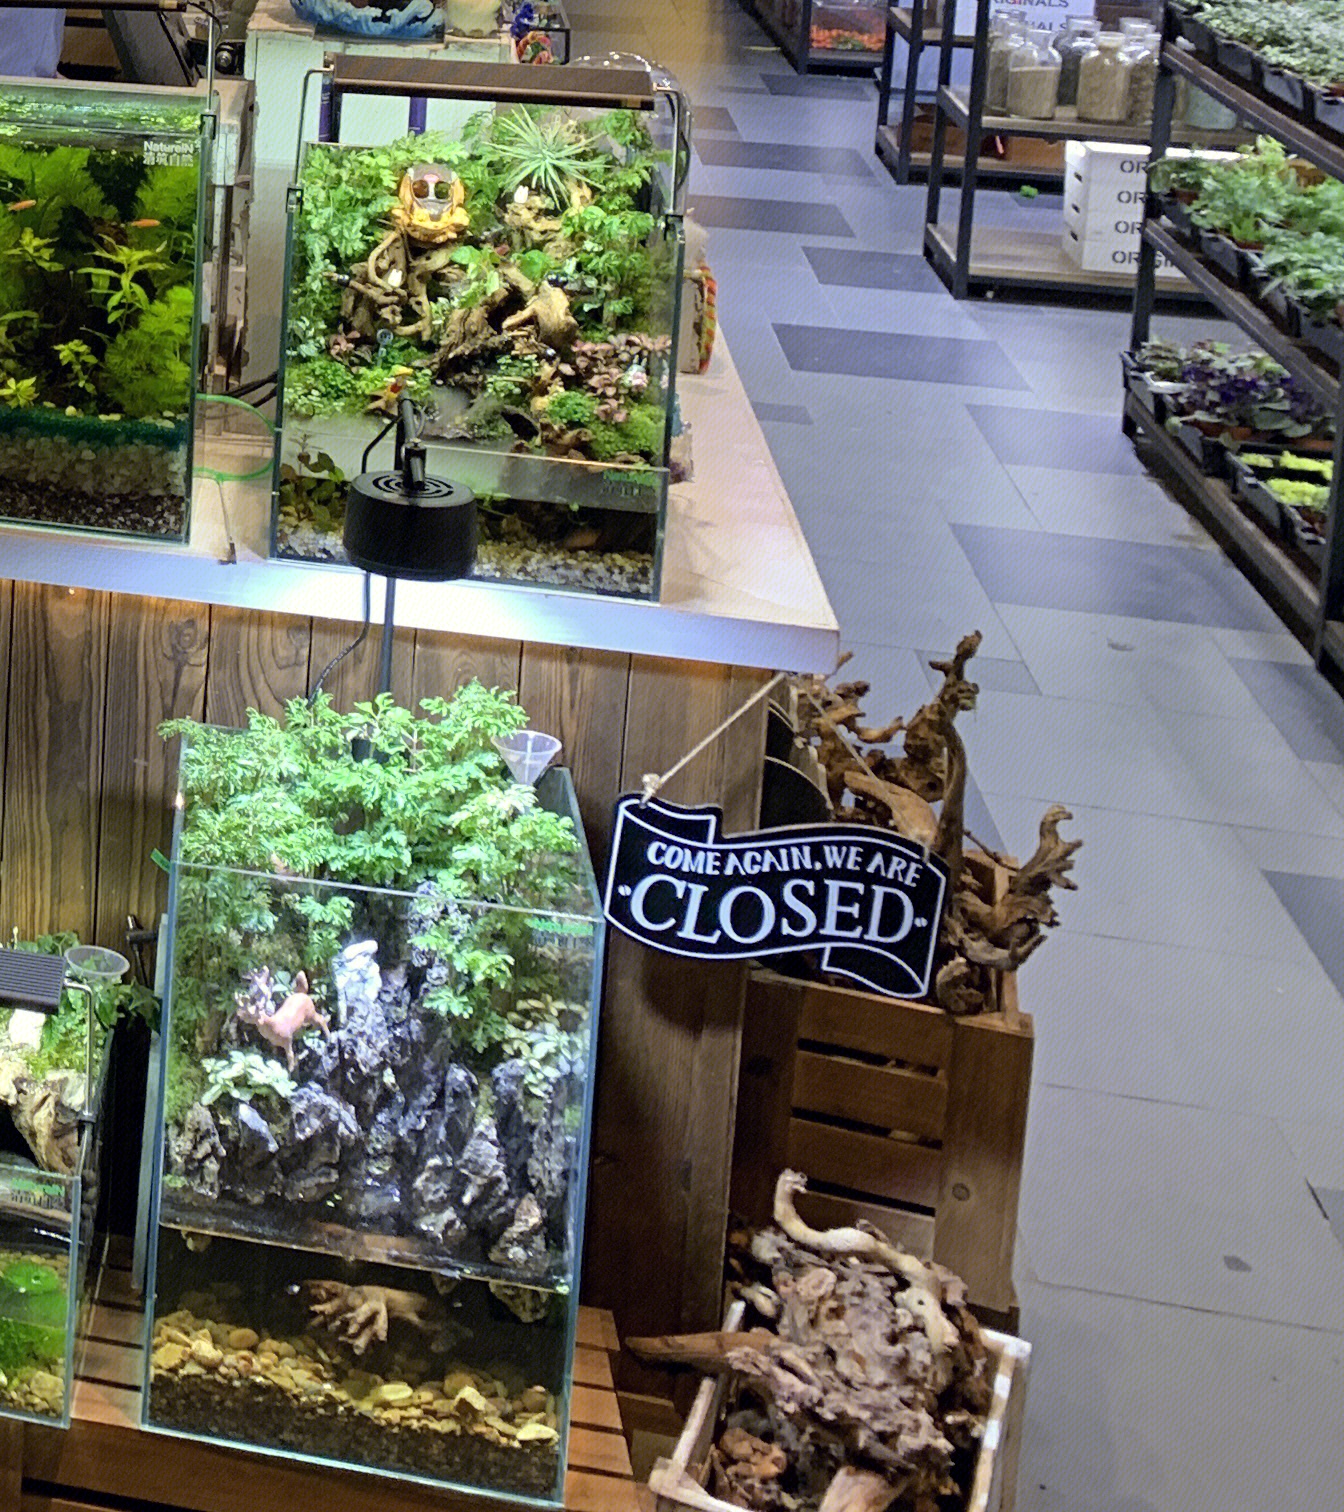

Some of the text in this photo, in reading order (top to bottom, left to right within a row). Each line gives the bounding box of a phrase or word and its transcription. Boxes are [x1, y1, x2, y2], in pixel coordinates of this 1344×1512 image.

[647, 841, 720, 876] COME
[825, 845, 862, 871] WE
[866, 850, 923, 887] ARE
[629, 874, 914, 945] CLOSED
